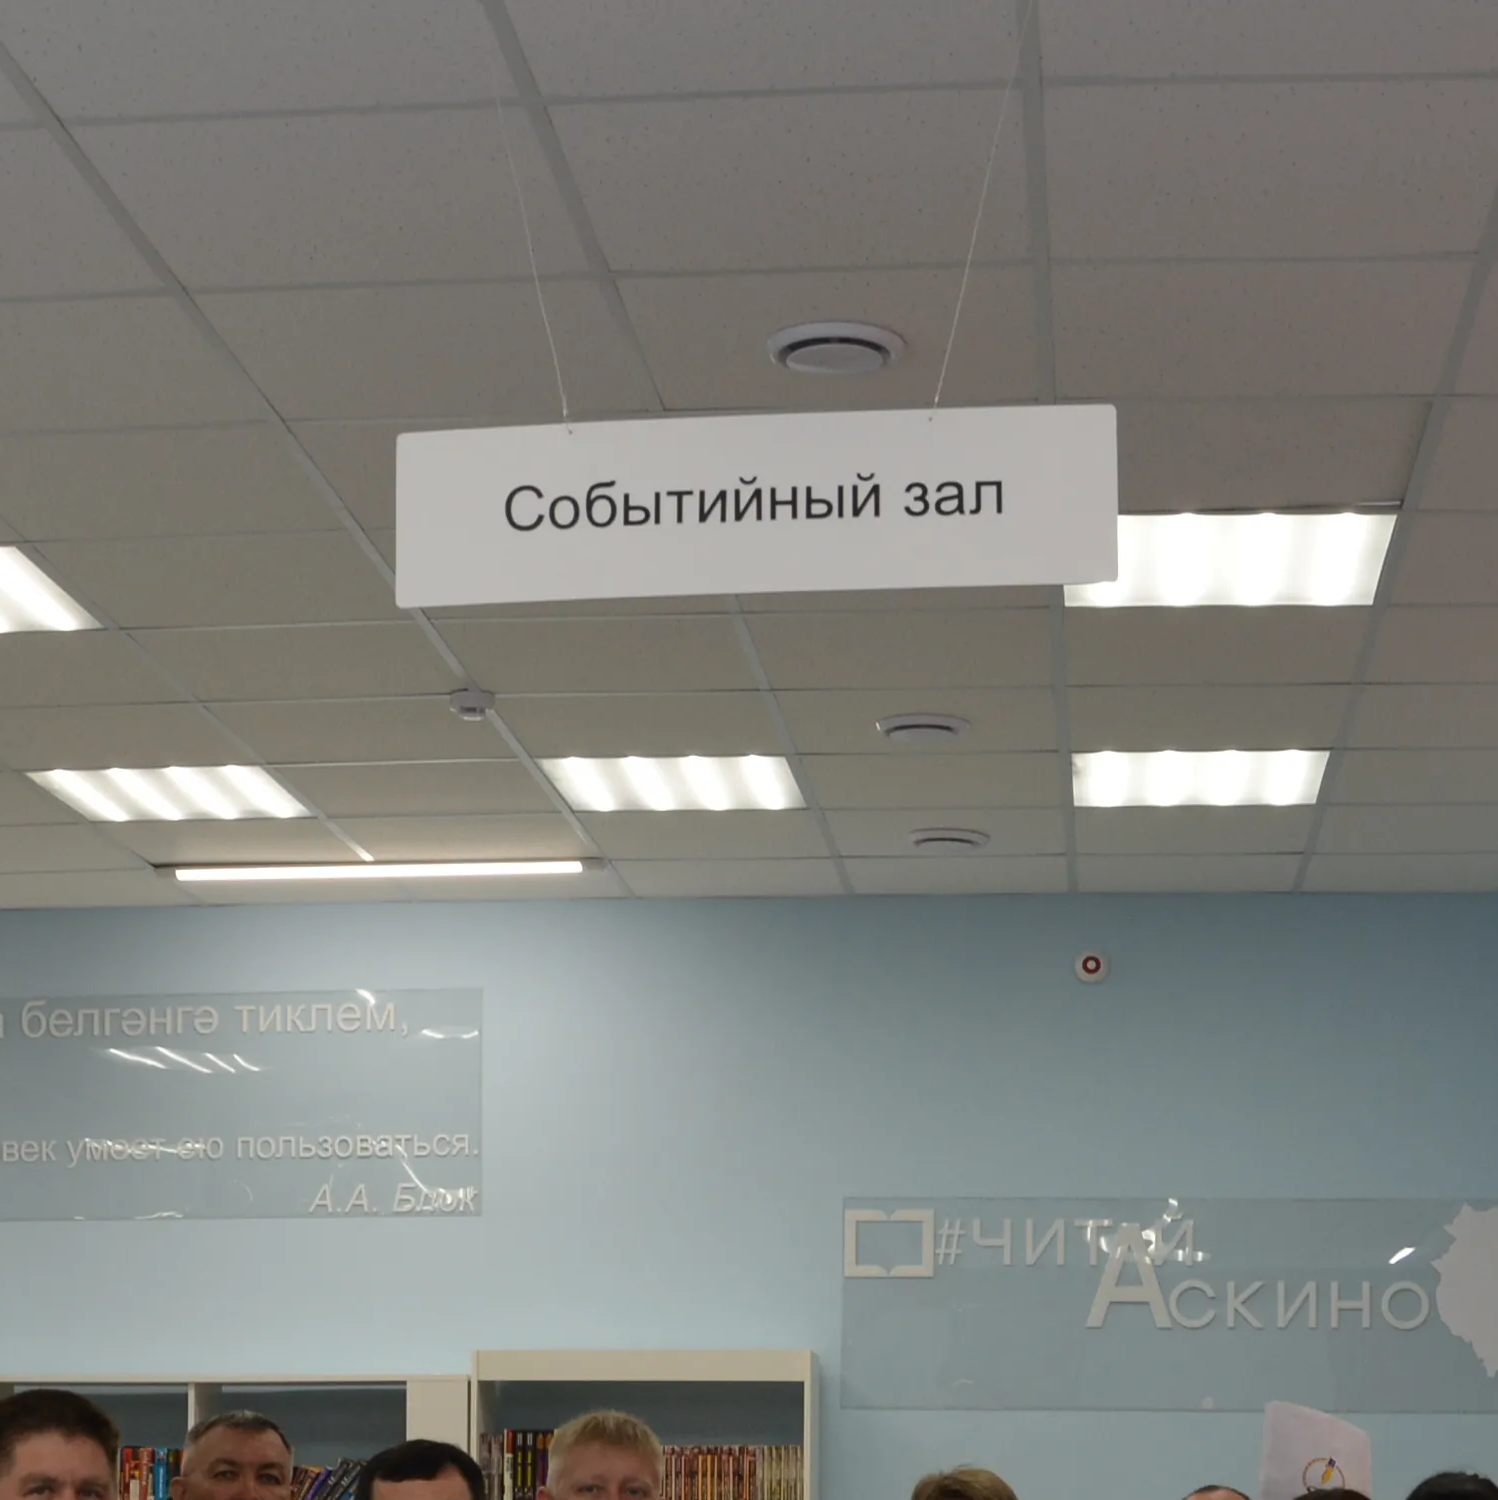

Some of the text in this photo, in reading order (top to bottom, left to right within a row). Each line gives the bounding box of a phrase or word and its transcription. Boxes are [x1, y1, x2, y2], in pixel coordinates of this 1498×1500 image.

[503, 474, 1003, 530] Событийный зал
[21, 1001, 220, 1039] белгәнгә
[234, 1003, 409, 1036] тиклем,
[67, 1138, 166, 1168] умеет
[177, 1139, 224, 1161] ею
[237, 1133, 480, 1160] пользоваться.
